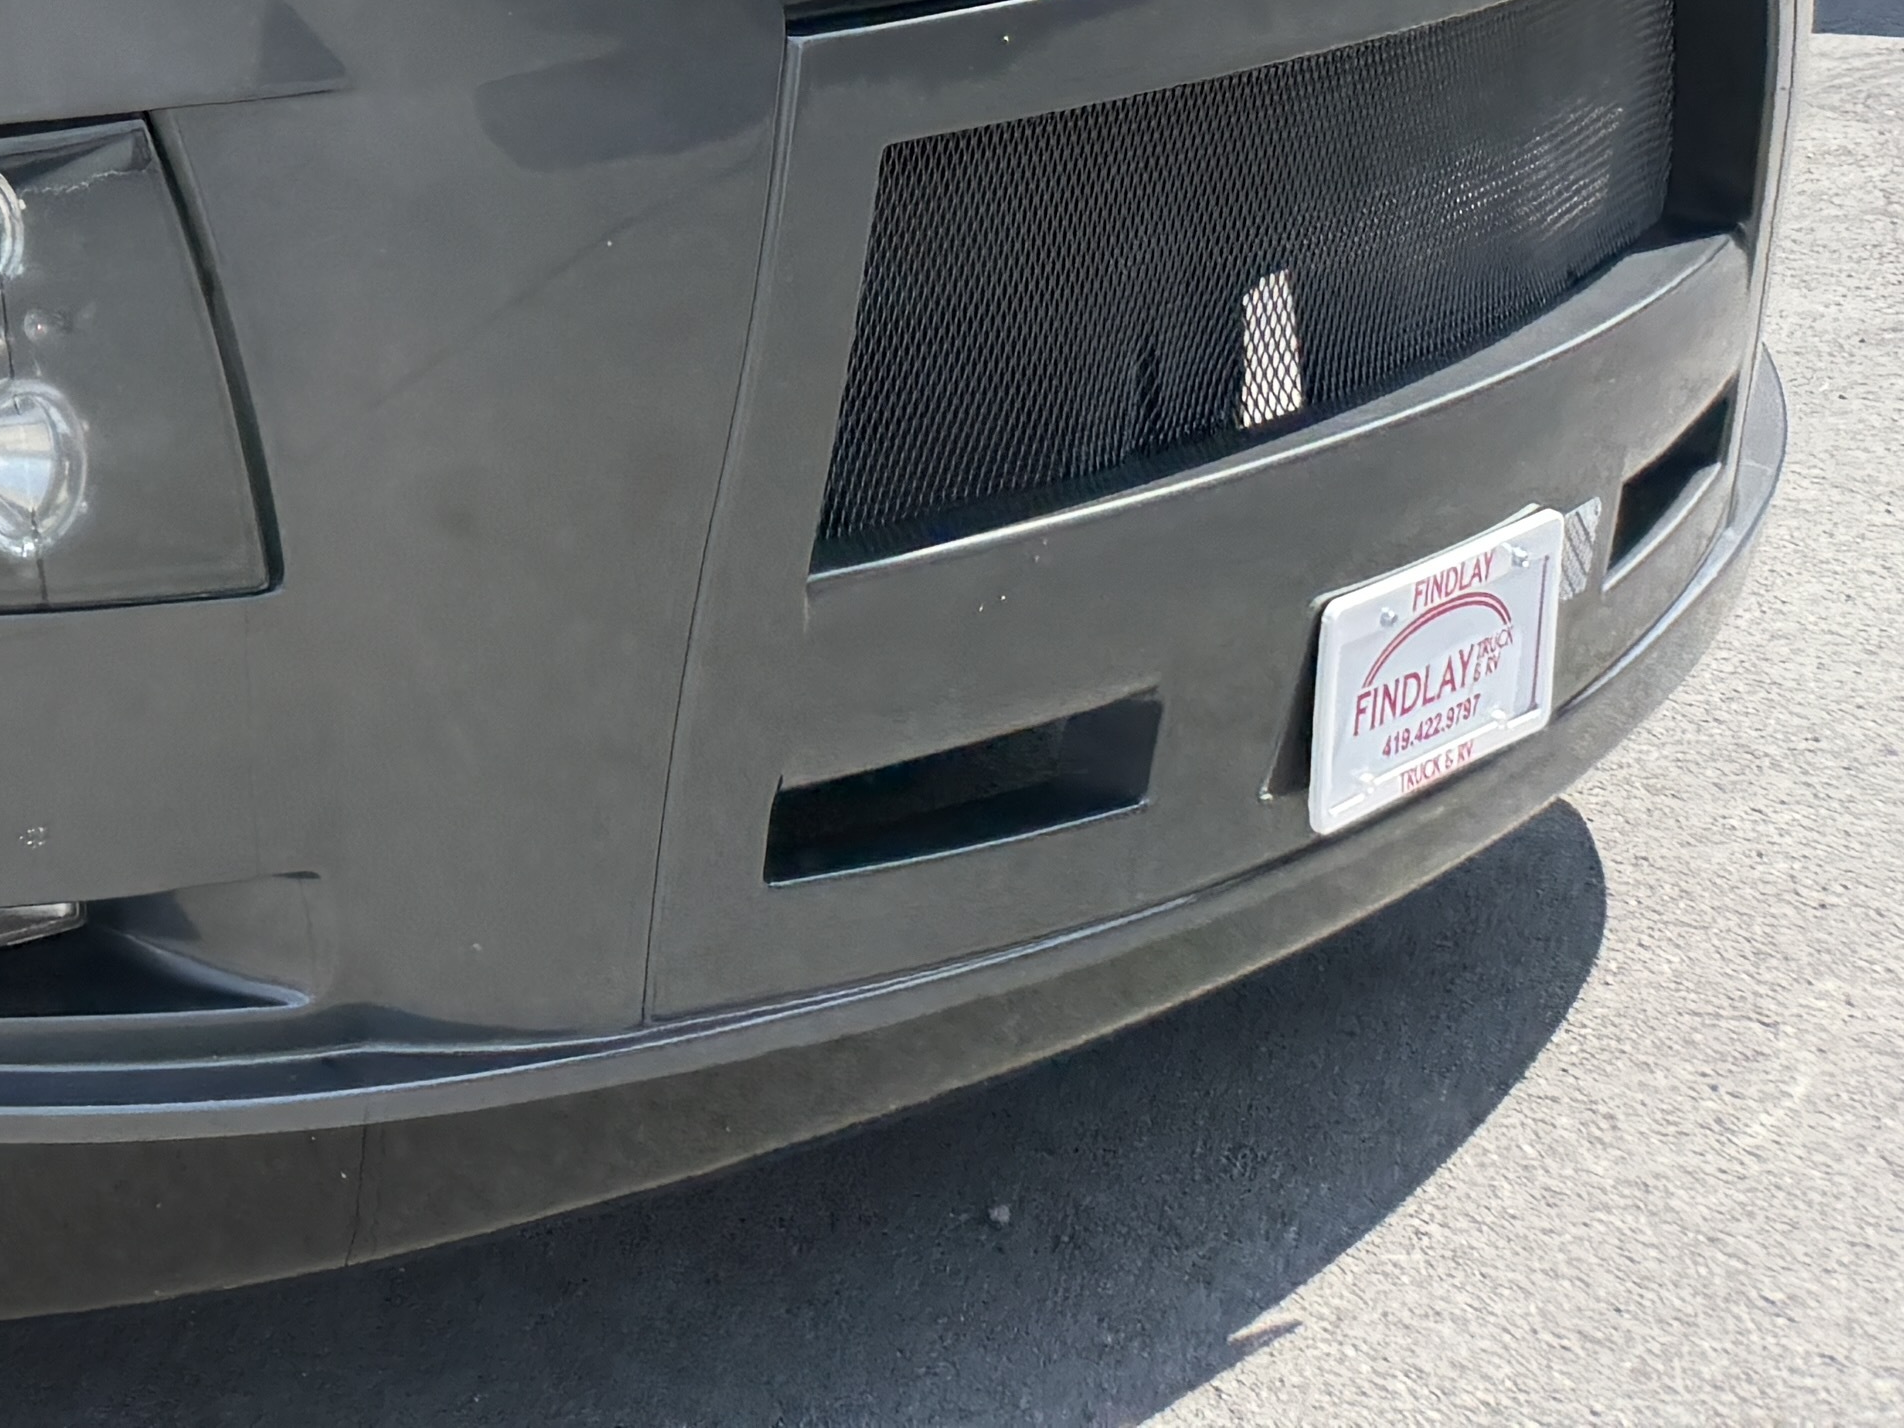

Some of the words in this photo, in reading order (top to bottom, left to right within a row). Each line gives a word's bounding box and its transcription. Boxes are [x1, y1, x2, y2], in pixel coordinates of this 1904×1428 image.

[1412, 551, 1494, 613] FINDLAY
[1476, 625, 1514, 660] TRUCK
[1484, 651, 1502, 675] RV
[1353, 644, 1476, 737] FINDLAY
[1382, 694, 1482, 757] 419.422.9797
[1398, 757, 1441, 794] TRUCK
[1457, 739, 1475, 762] RV
